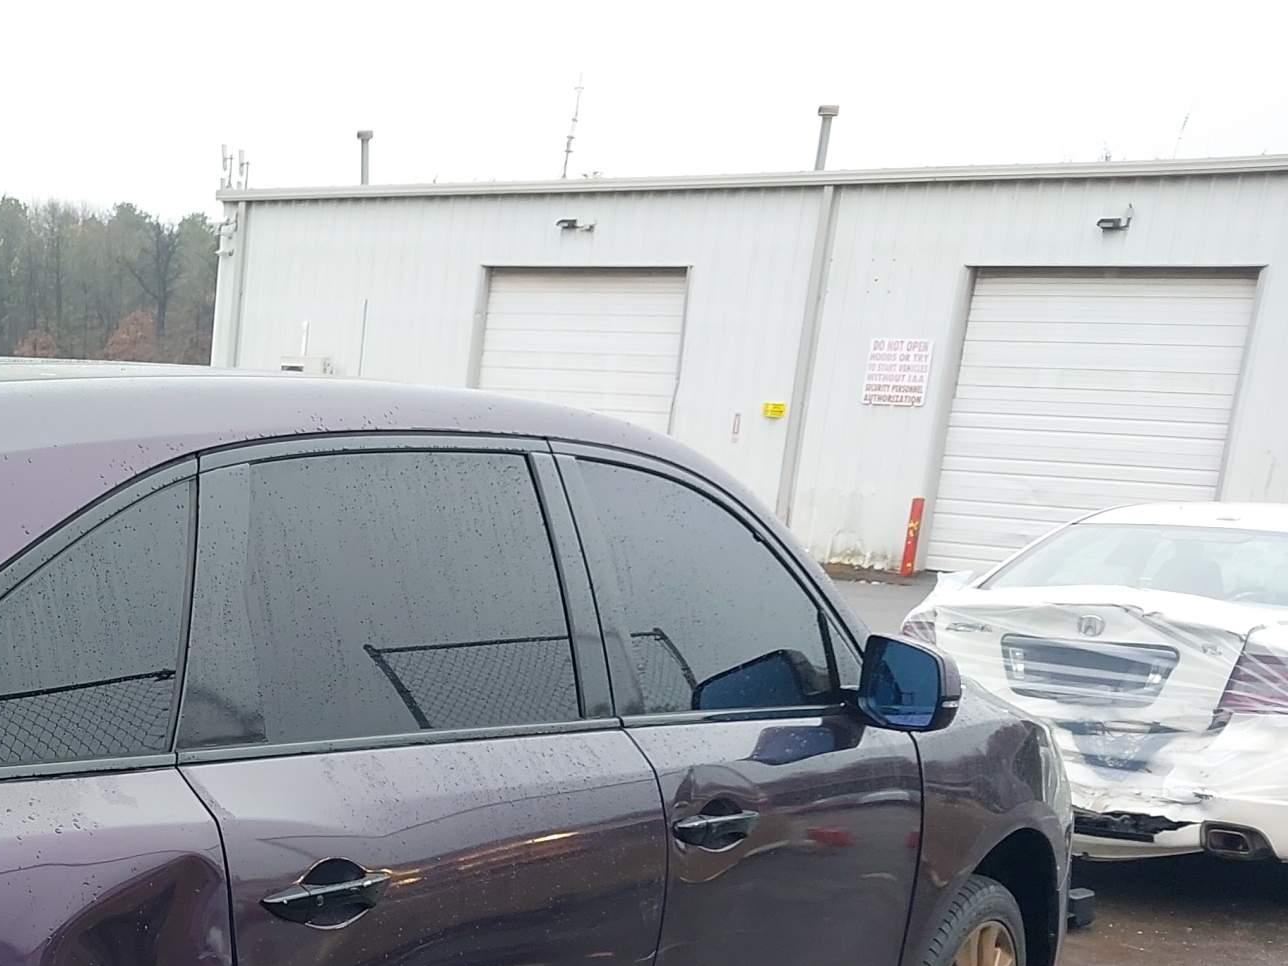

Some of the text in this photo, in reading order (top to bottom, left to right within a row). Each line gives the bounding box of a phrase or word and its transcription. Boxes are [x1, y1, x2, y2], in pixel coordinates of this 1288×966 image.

[873, 340, 929, 352] DO NOT OPEN
[870, 352, 929, 363] HOODS OR TRY
[866, 373, 906, 382] WITHOUT
[863, 394, 922, 403] AUTHORIZATION
